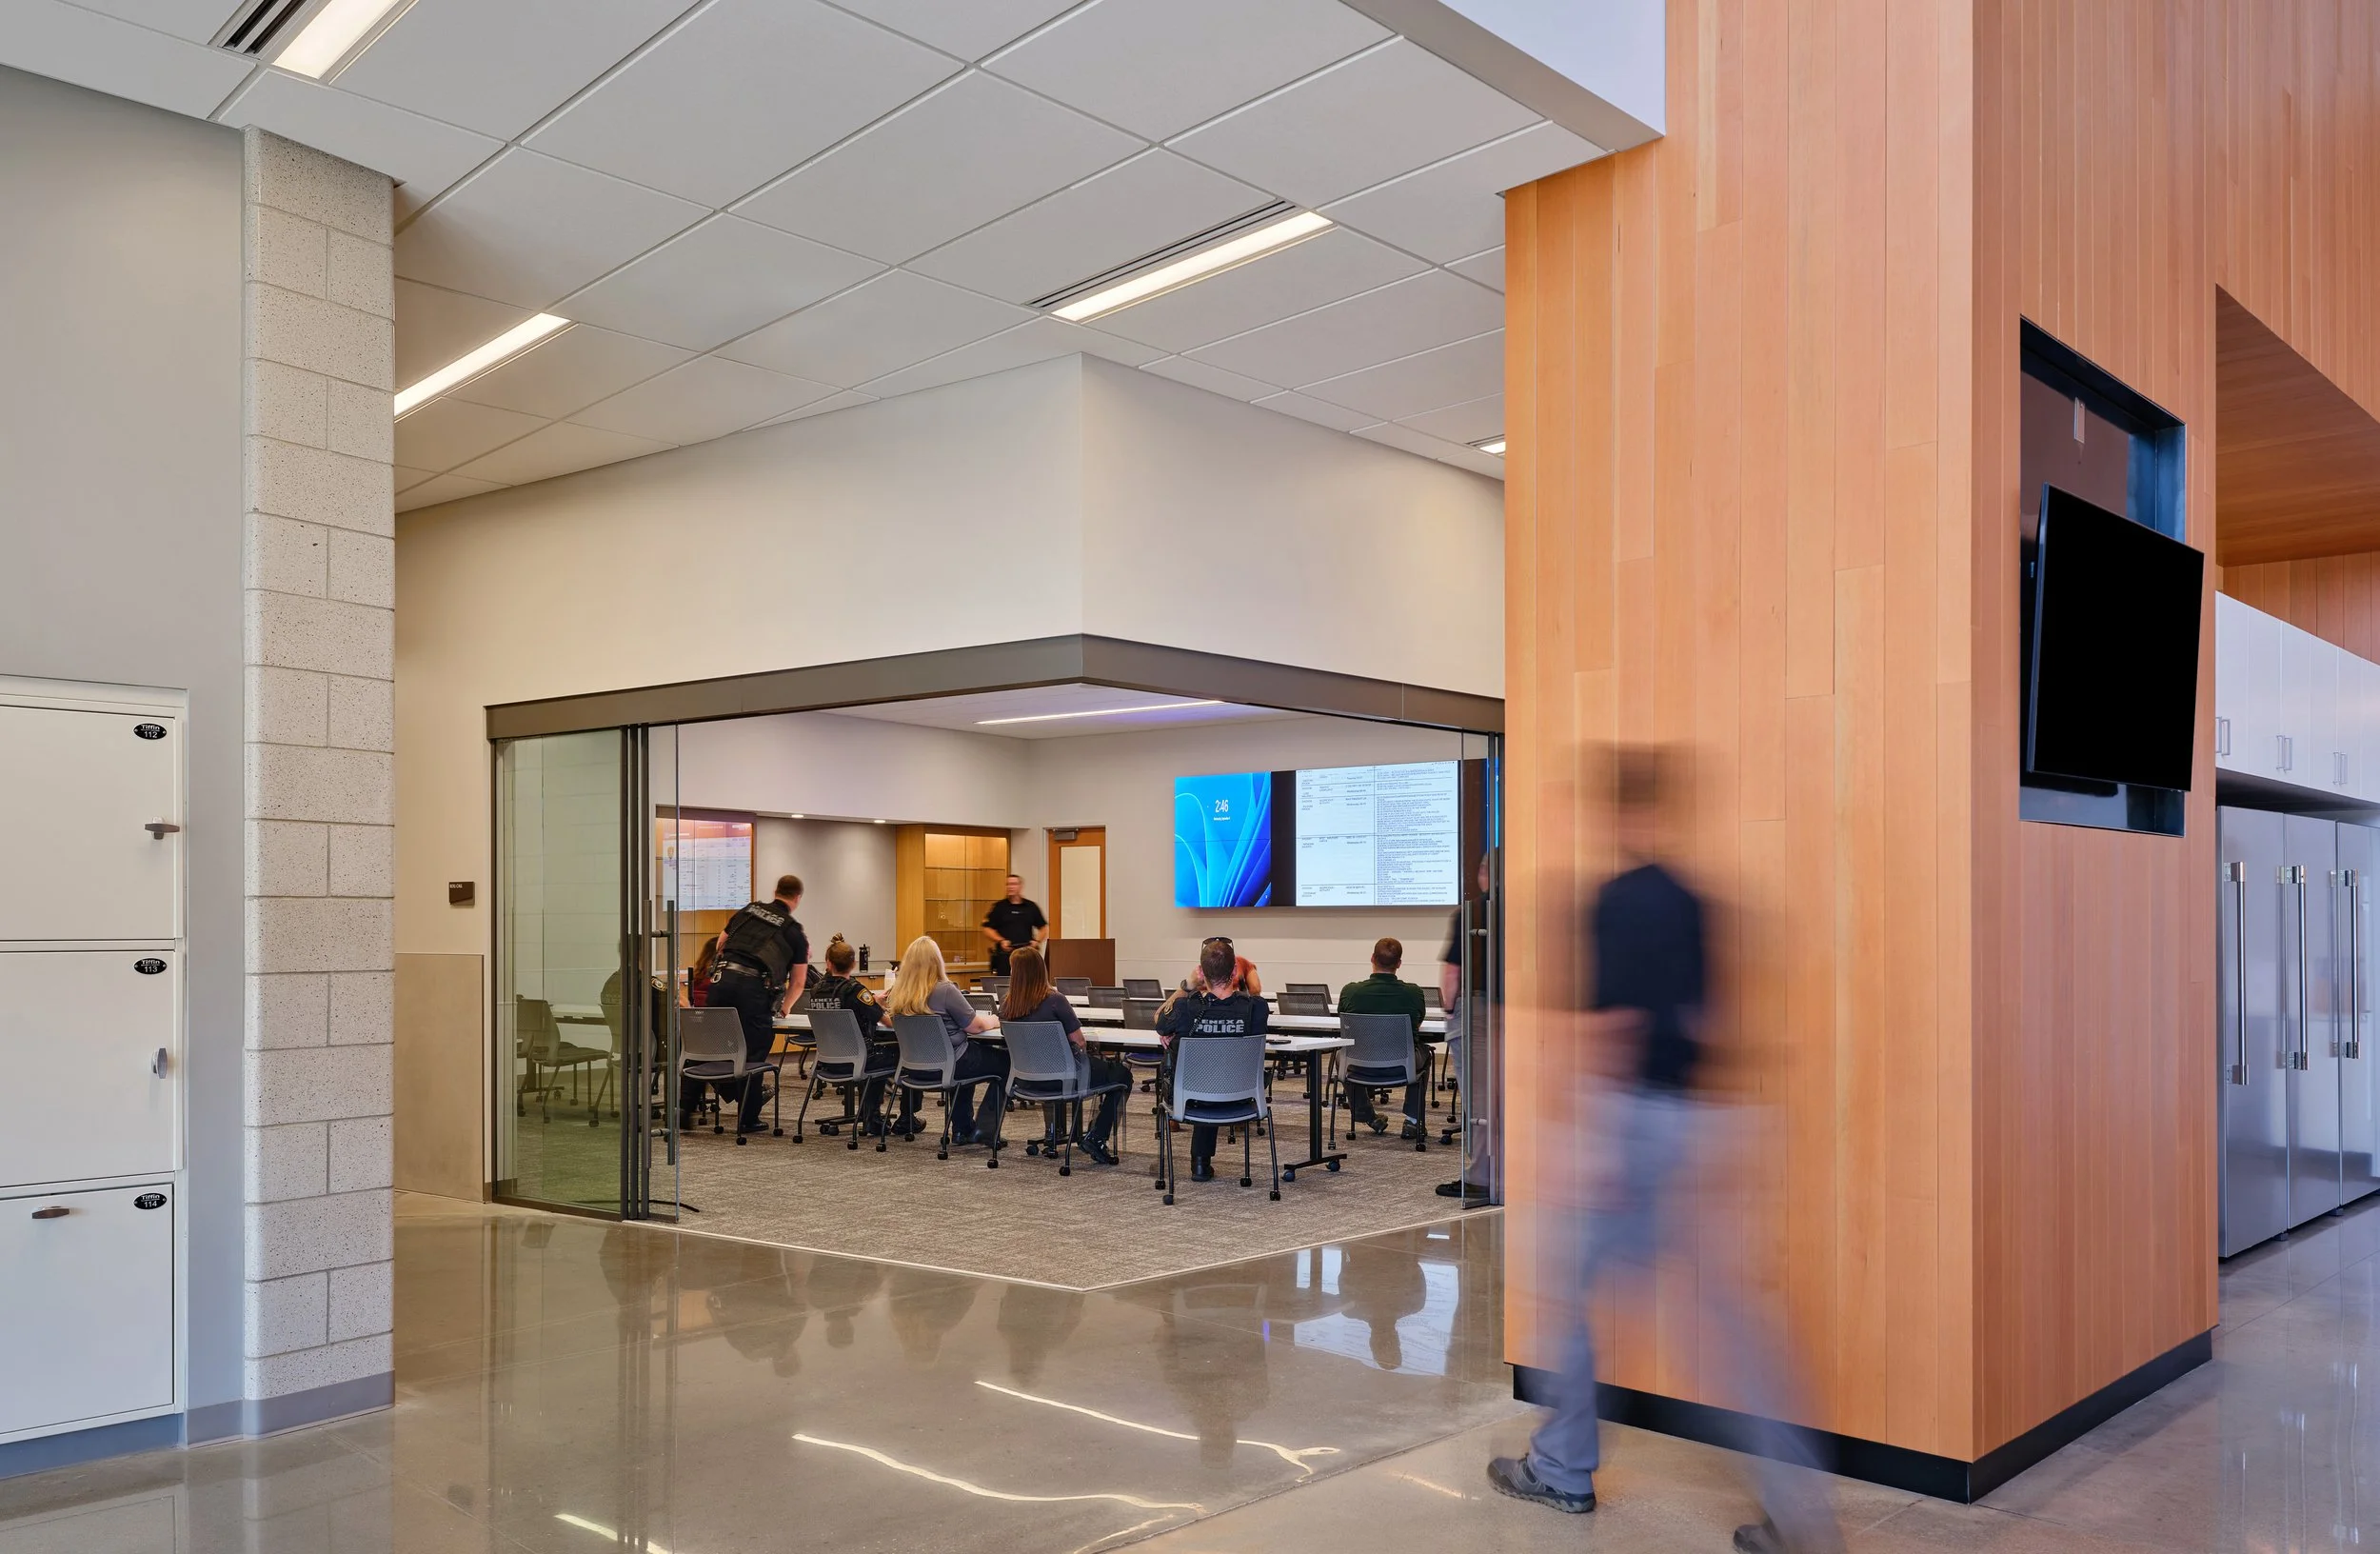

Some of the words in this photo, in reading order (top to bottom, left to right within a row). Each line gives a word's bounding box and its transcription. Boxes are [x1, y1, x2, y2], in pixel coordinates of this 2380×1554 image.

[1215, 799, 1229, 812] 2:46
[746, 906, 783, 926] POLICE
[1196, 1024, 1244, 1033] POLICE
